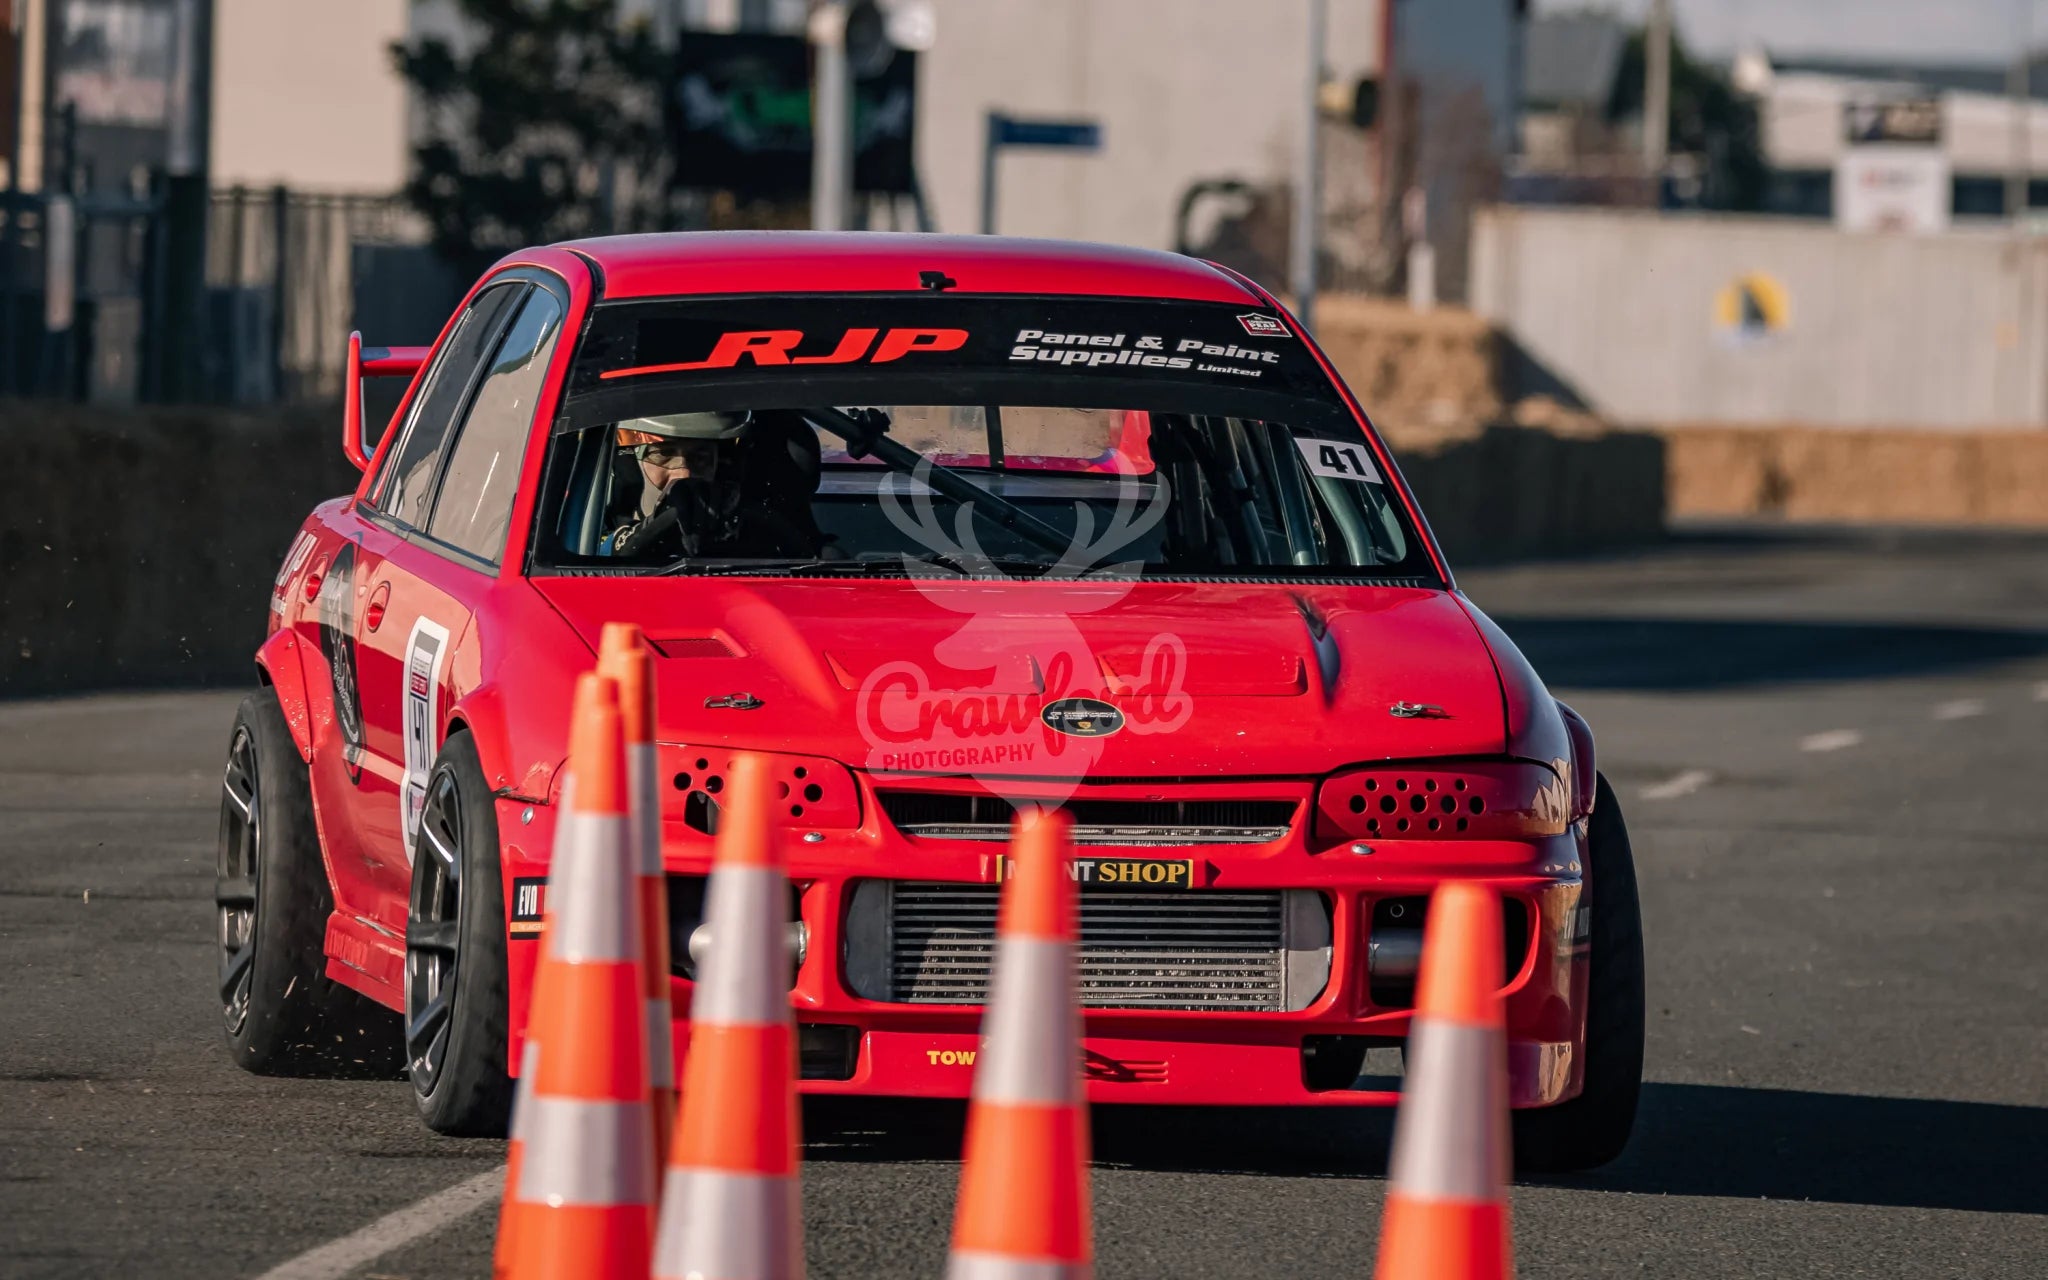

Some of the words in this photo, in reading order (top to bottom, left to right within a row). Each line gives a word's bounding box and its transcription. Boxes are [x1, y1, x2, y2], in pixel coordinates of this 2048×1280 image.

[600, 328, 969, 378] RJP
[1008, 345, 1193, 369] Supplies
[1197, 364, 1262, 378] Limited
[1016, 329, 1125, 347] Panel
[1136, 335, 1164, 350] &
[1178, 338, 1281, 364] Paint
[1319, 445, 1368, 476] 41
[1098, 862, 1187, 884] SHOP
[518, 885, 537, 915] EVO
[926, 1050, 977, 1066] TOW
